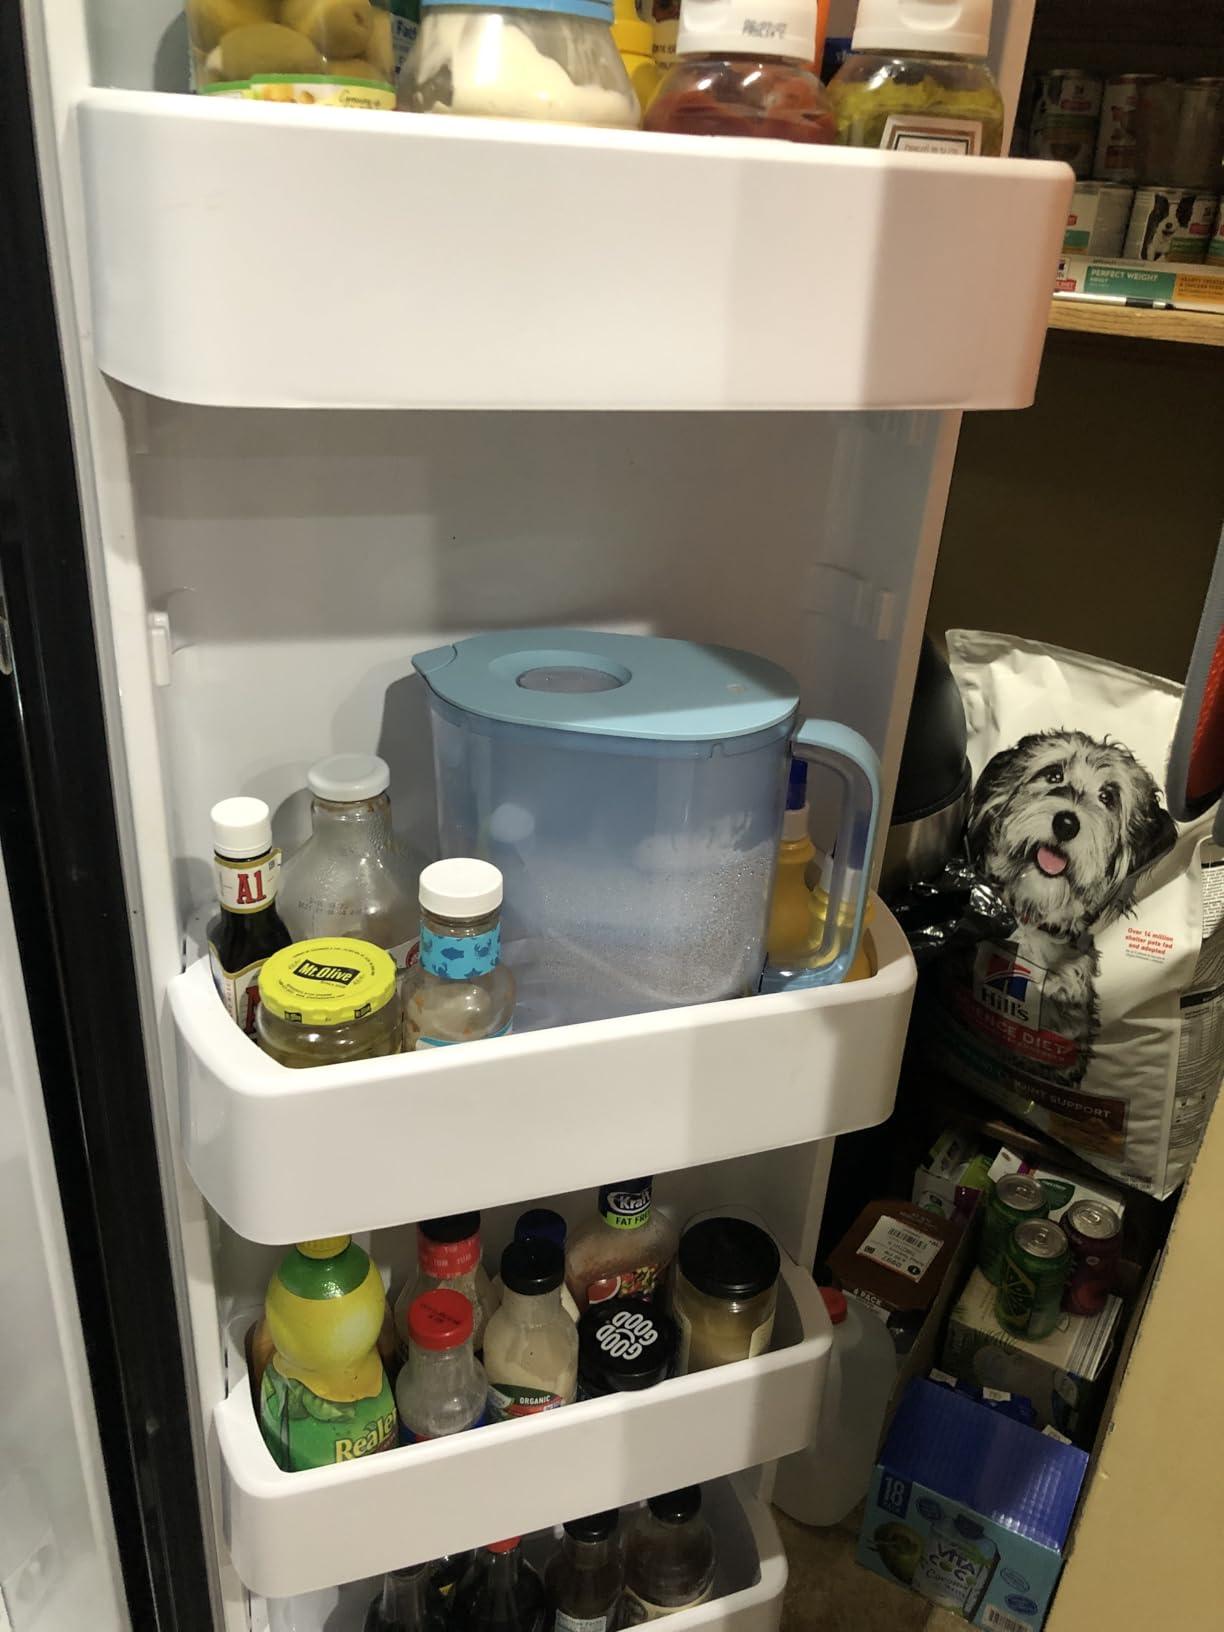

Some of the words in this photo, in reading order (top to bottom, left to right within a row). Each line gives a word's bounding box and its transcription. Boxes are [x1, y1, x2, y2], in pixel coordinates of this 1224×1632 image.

[1091, 269, 1124, 279] PERFECT
[1127, 272, 1159, 282] WEIGHT
[316, 964, 353, 982] Olive
[982, 987, 1029, 1022] Hill's
[1022, 1033, 1065, 1055] DIET
[1050, 1094, 1112, 1119] SUPPORT
[619, 1188, 650, 1209] Kraft
[616, 1217, 633, 1225] FAT
[860, 1291, 883, 1305] PACK
[612, 1311, 658, 1346] GOOD
[596, 1324, 643, 1360] GOOD
[520, 1395, 551, 1405] ORGANIC
[884, 1476, 906, 1503] 18
[937, 1543, 975, 1575] VITA
